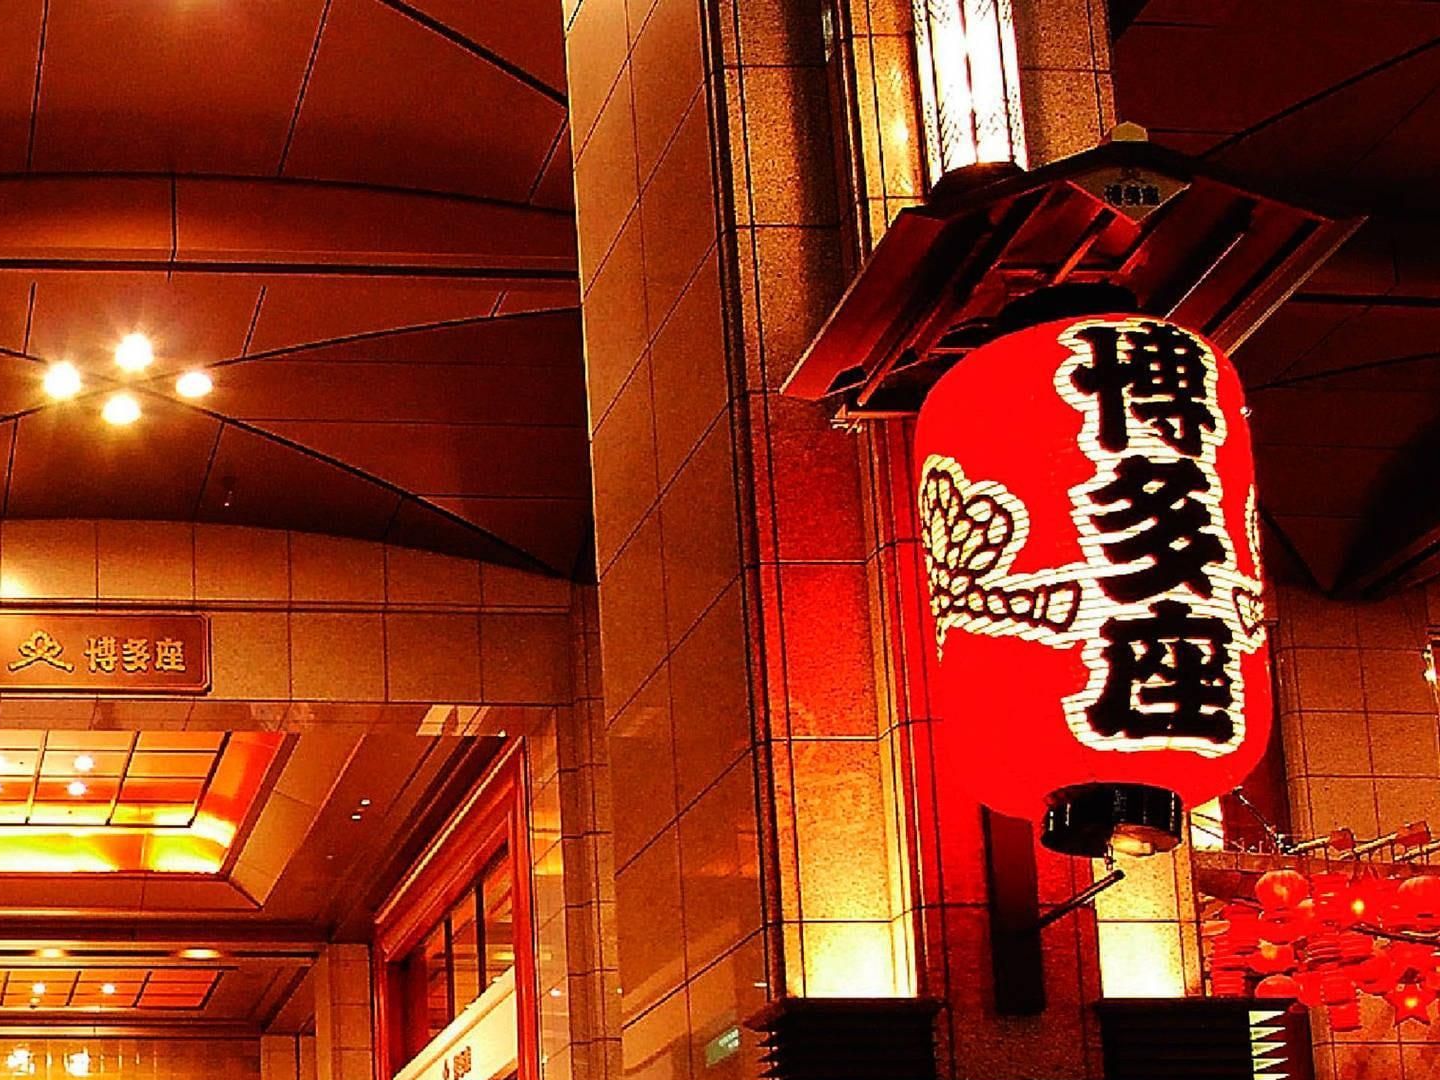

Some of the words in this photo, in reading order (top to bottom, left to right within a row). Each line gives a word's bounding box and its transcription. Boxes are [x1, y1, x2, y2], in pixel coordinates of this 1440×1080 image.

[1070, 321, 1234, 744] 博多座
[84, 636, 186, 672] 博多座
